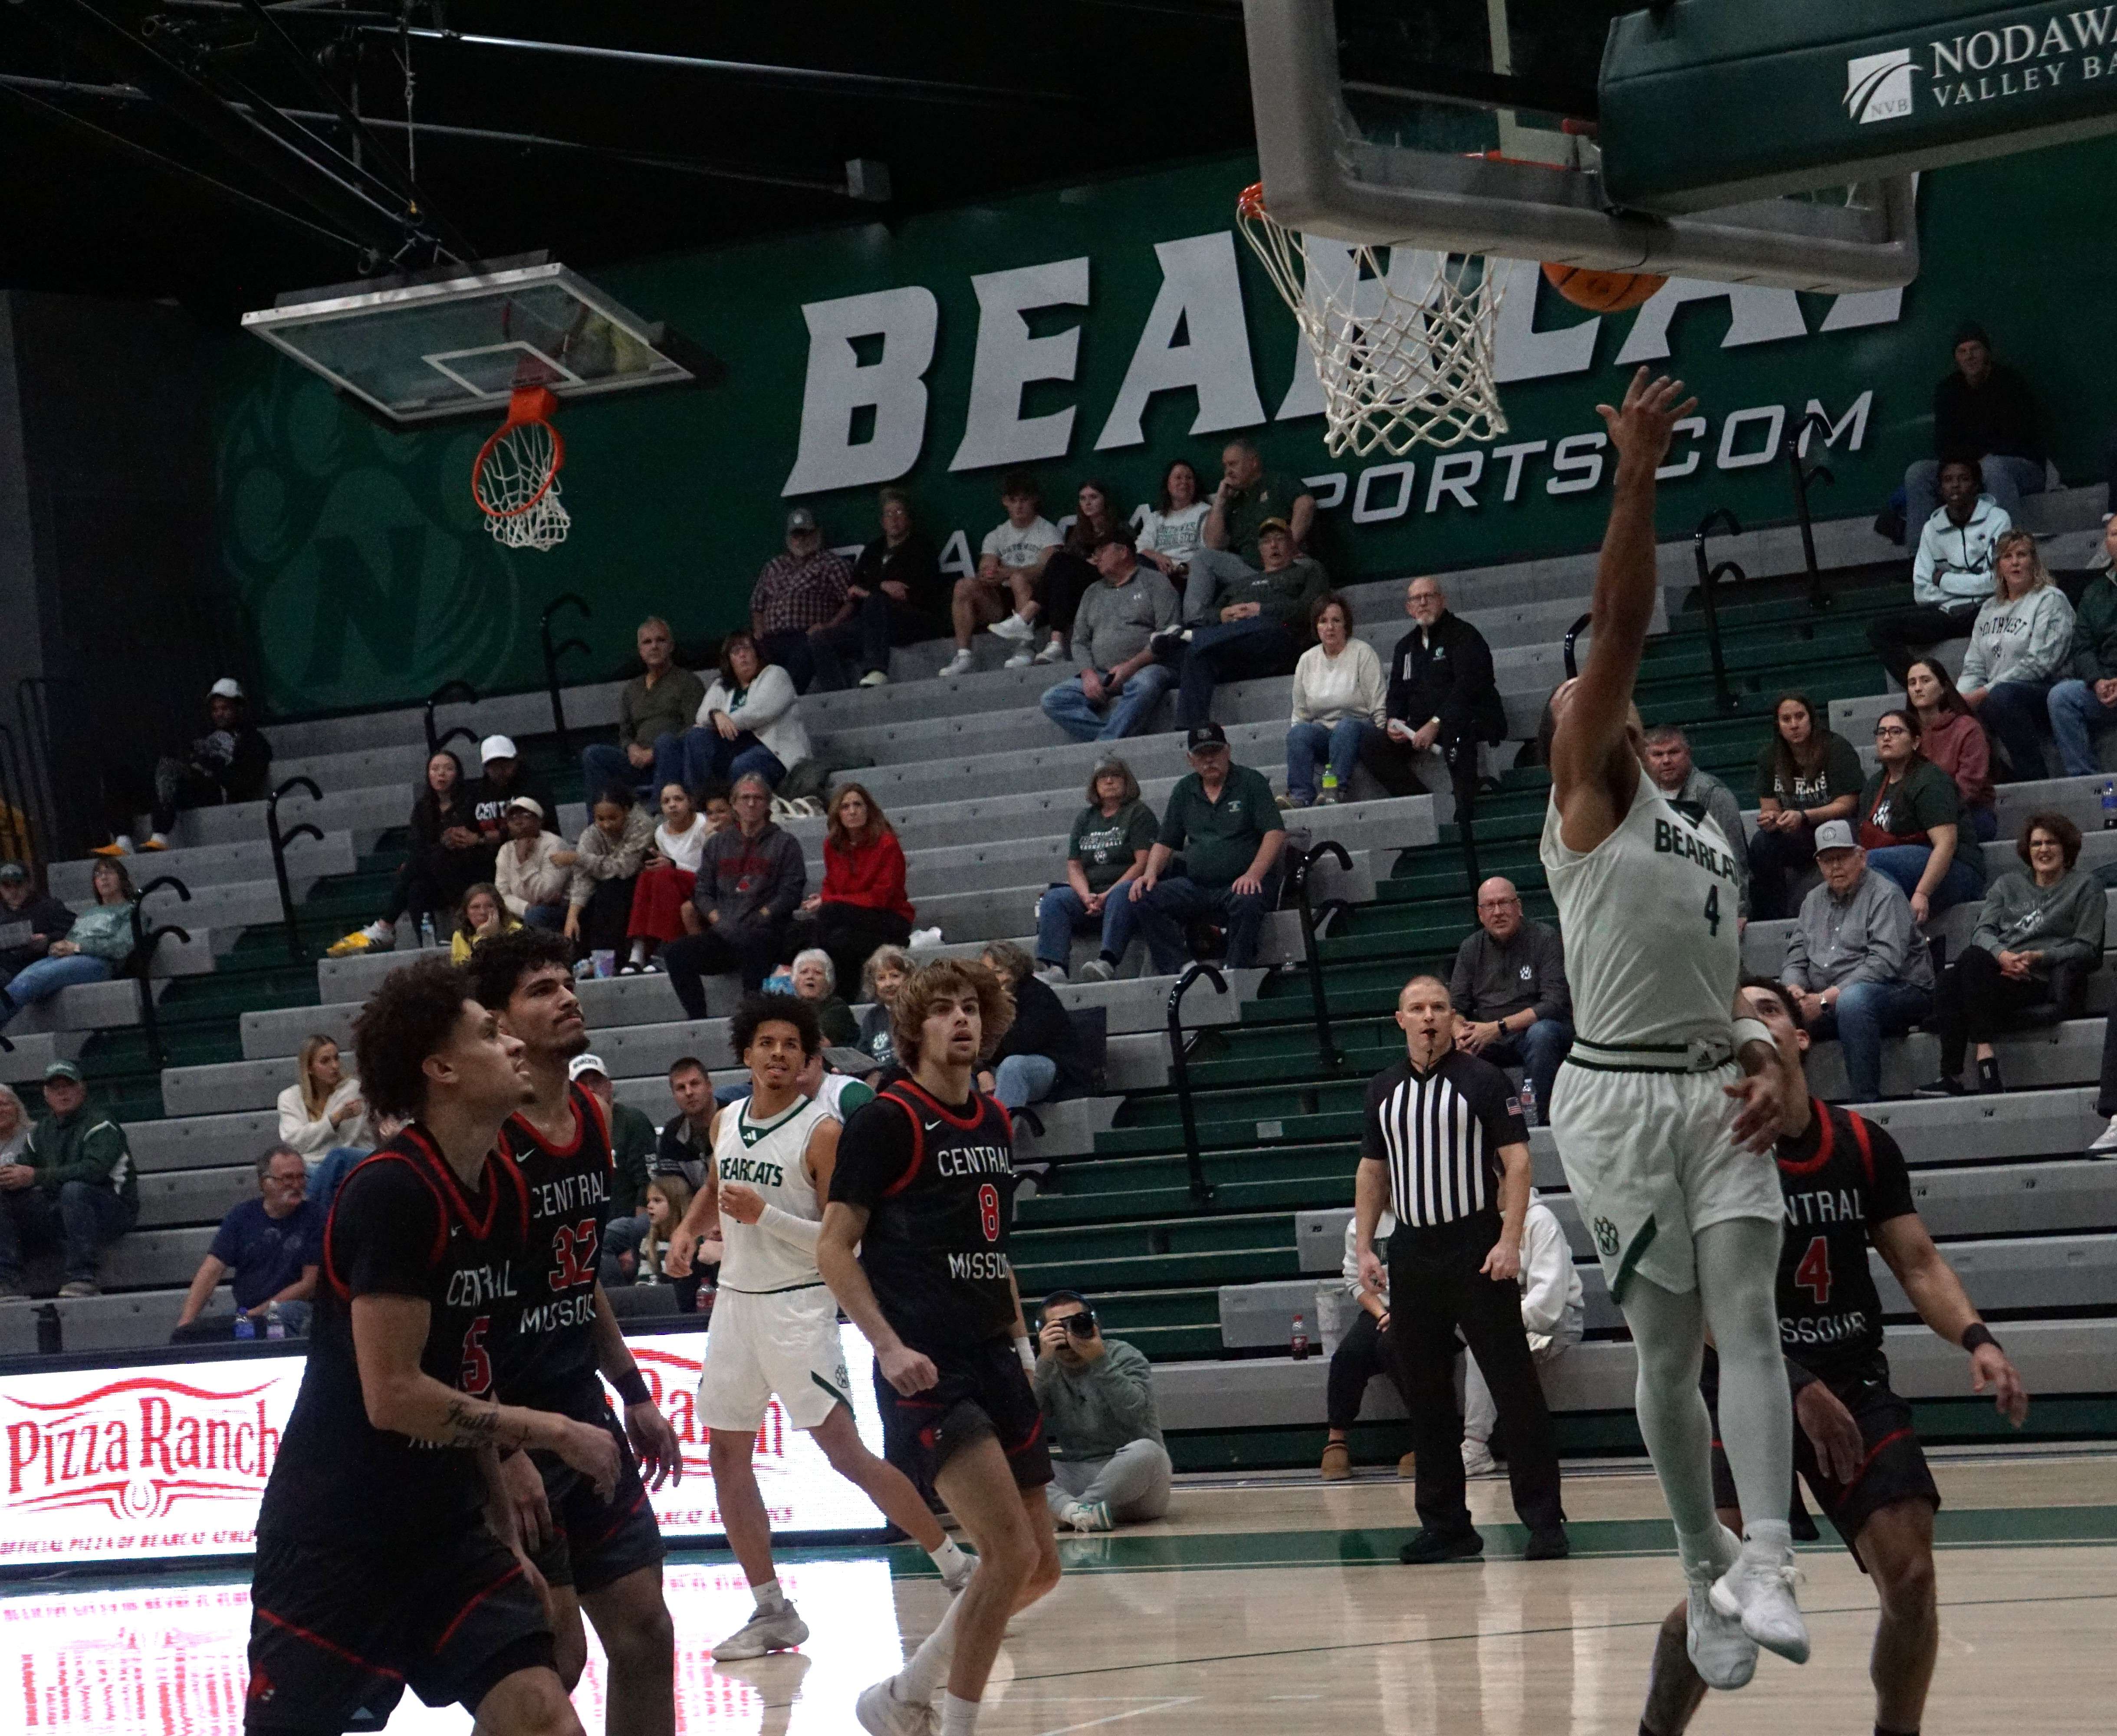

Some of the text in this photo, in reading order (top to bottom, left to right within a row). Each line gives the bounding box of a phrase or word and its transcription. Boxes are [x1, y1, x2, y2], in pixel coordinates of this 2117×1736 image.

[1929, 5, 2117, 79] NODAW
[1870, 99, 1909, 118] NVB
[1933, 62, 2064, 108] VALLEY
[1704, 884, 1720, 937] 4
[937, 1146, 1016, 1177] CENTRAL
[978, 1183, 999, 1242] 8
[548, 1217, 598, 1292] 32
[1794, 1236, 1831, 1304] 4
[461, 1315, 493, 1395] 5
[6, 1396, 279, 1495] Pizza Ranch
